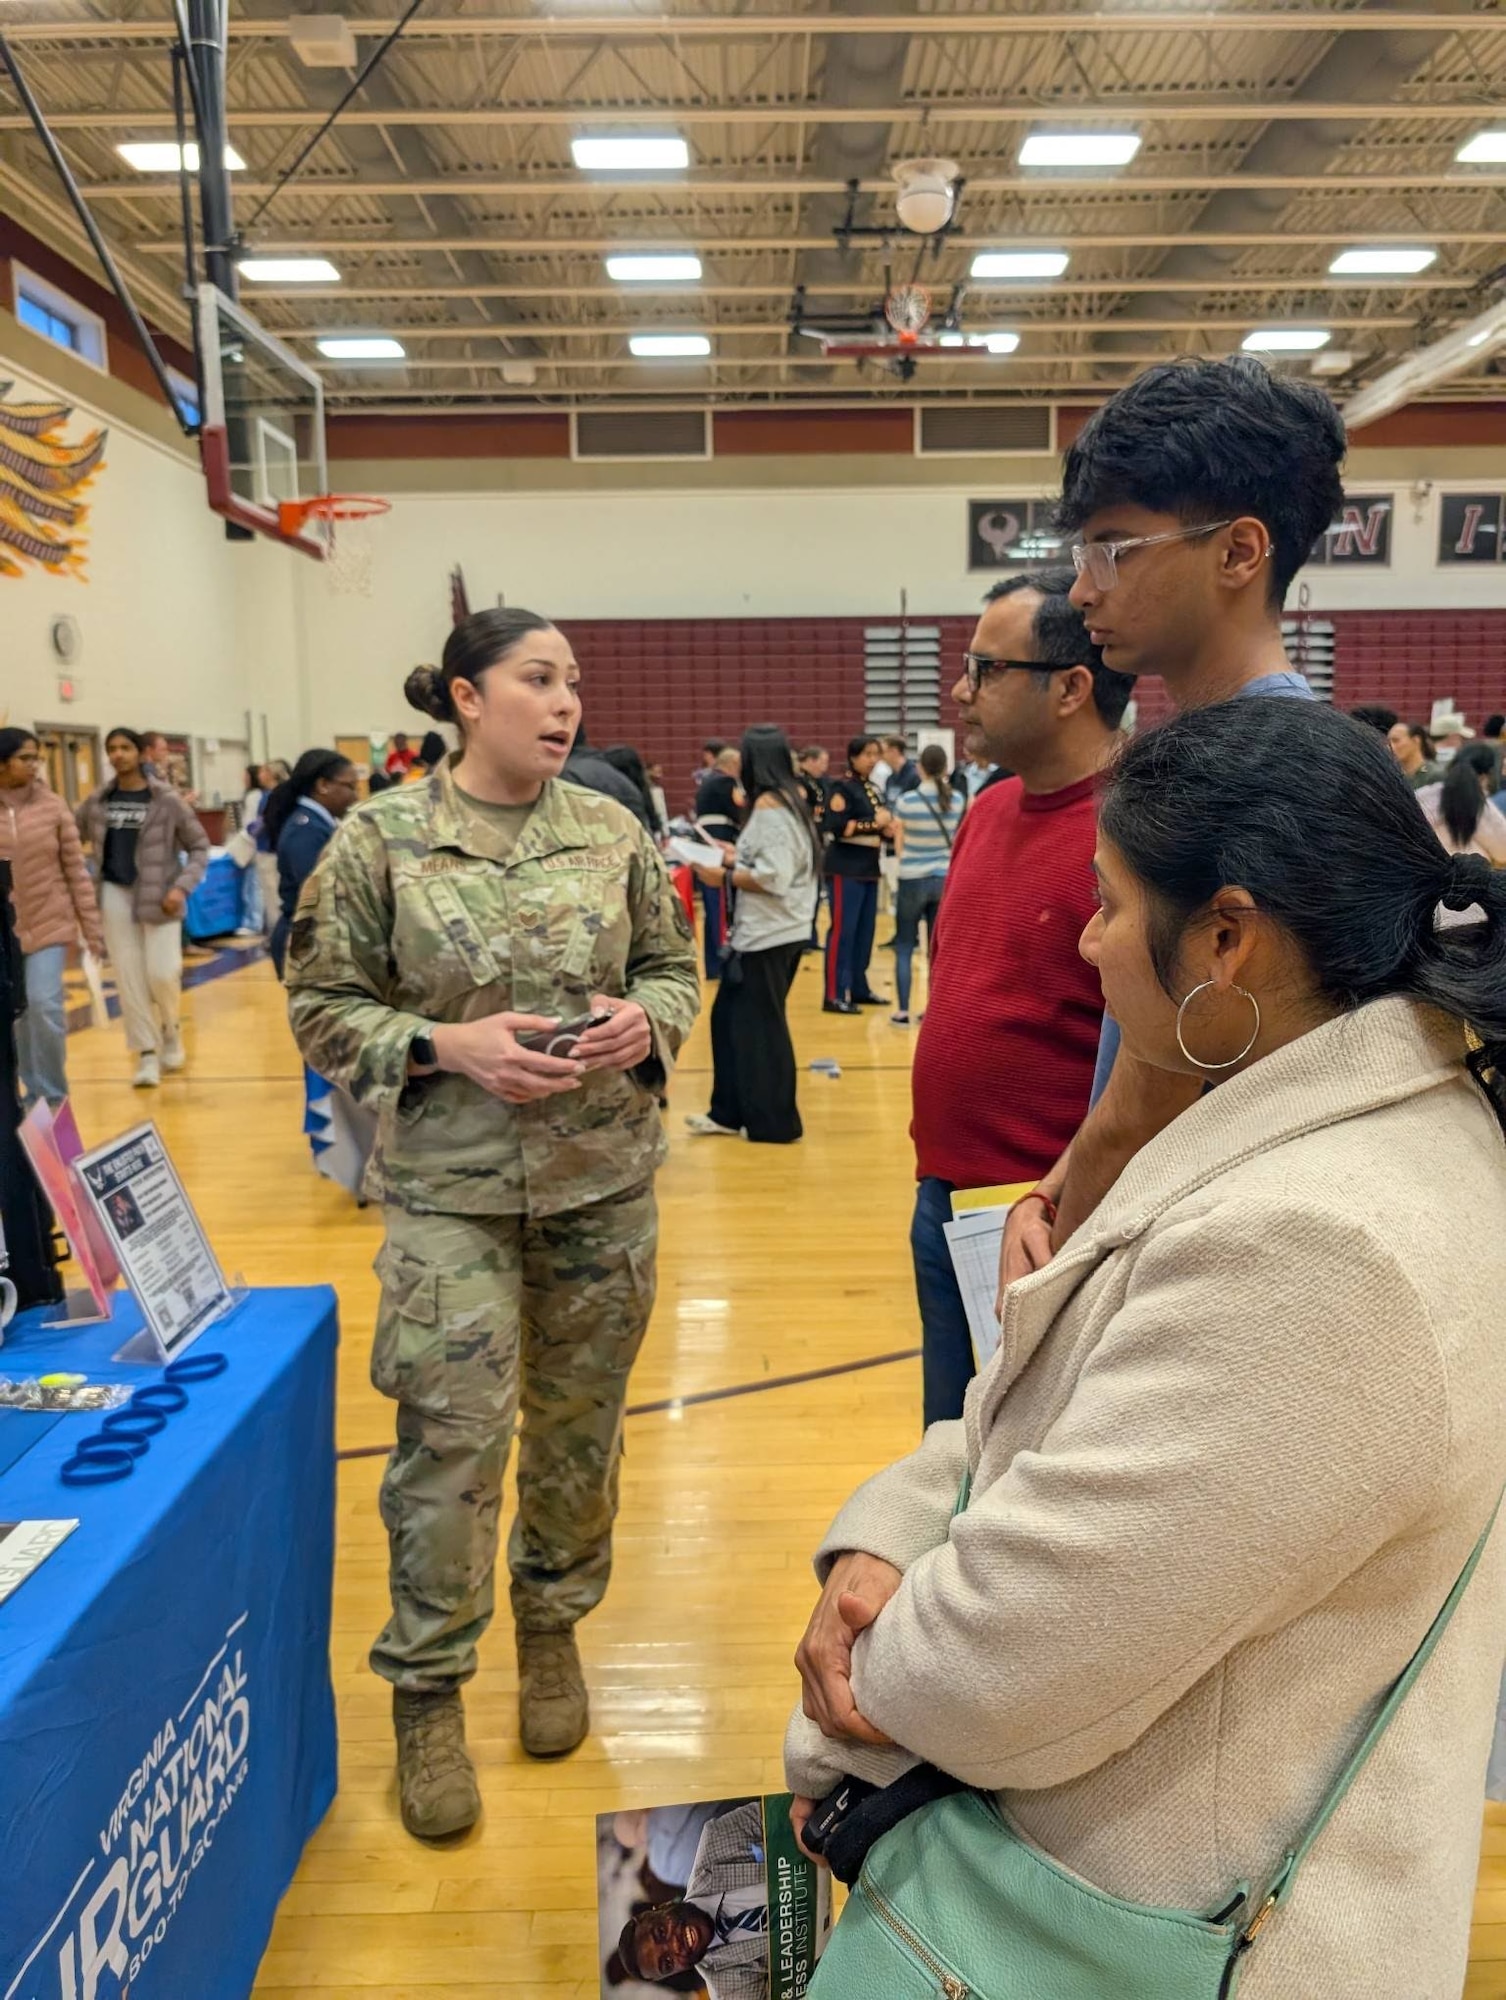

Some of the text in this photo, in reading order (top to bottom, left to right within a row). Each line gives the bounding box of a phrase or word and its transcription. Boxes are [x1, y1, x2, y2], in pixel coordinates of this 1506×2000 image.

[99, 1718, 176, 1856] VIRGINIA
[130, 1649, 248, 1872] NATIONAL
[59, 1696, 250, 2000] IR GUARD
[793, 1862, 809, 1955] INSTITUTE
[776, 1856, 794, 1999] & LEADERSHIP
